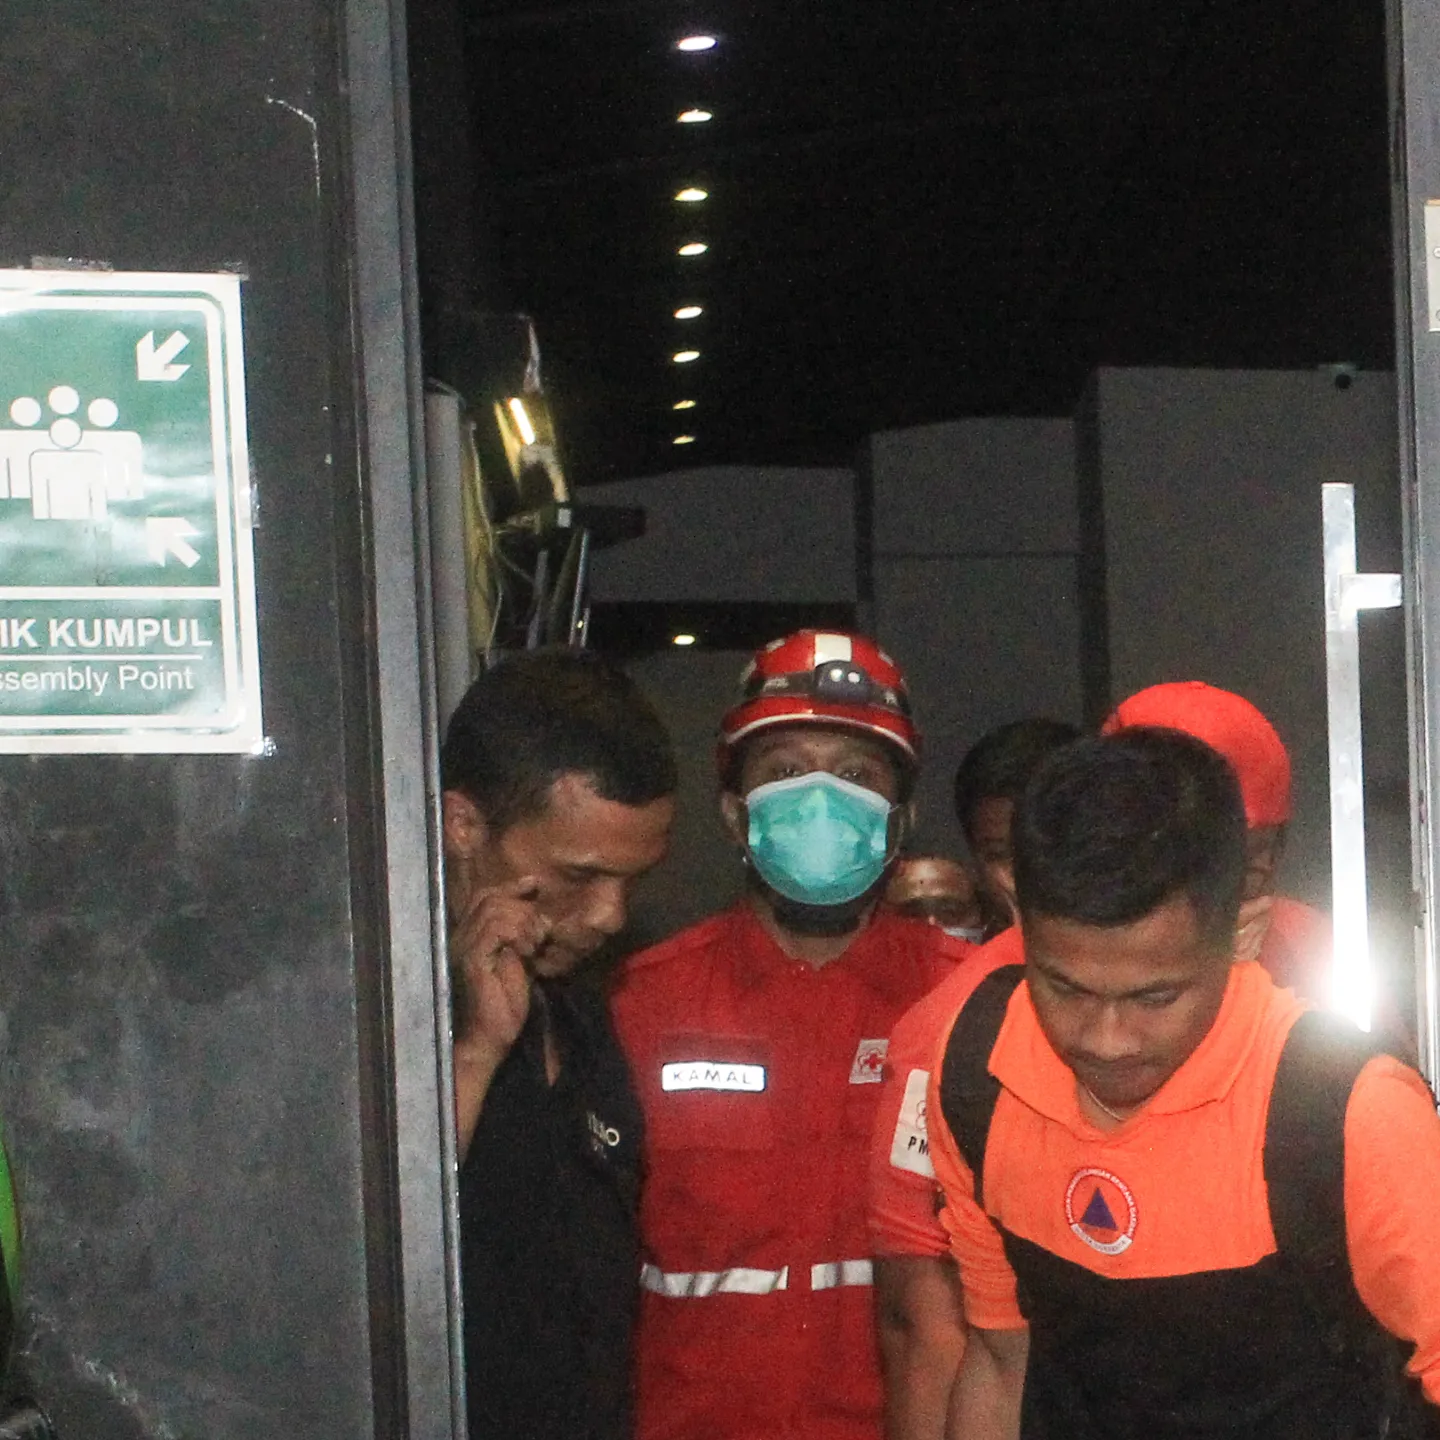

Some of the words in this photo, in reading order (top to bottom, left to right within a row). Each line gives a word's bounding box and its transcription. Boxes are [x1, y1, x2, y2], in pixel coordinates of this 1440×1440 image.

[48, 617, 213, 648] KUMPUL
[118, 664, 195, 691] Point
[673, 1069, 753, 1085] KAMAL
